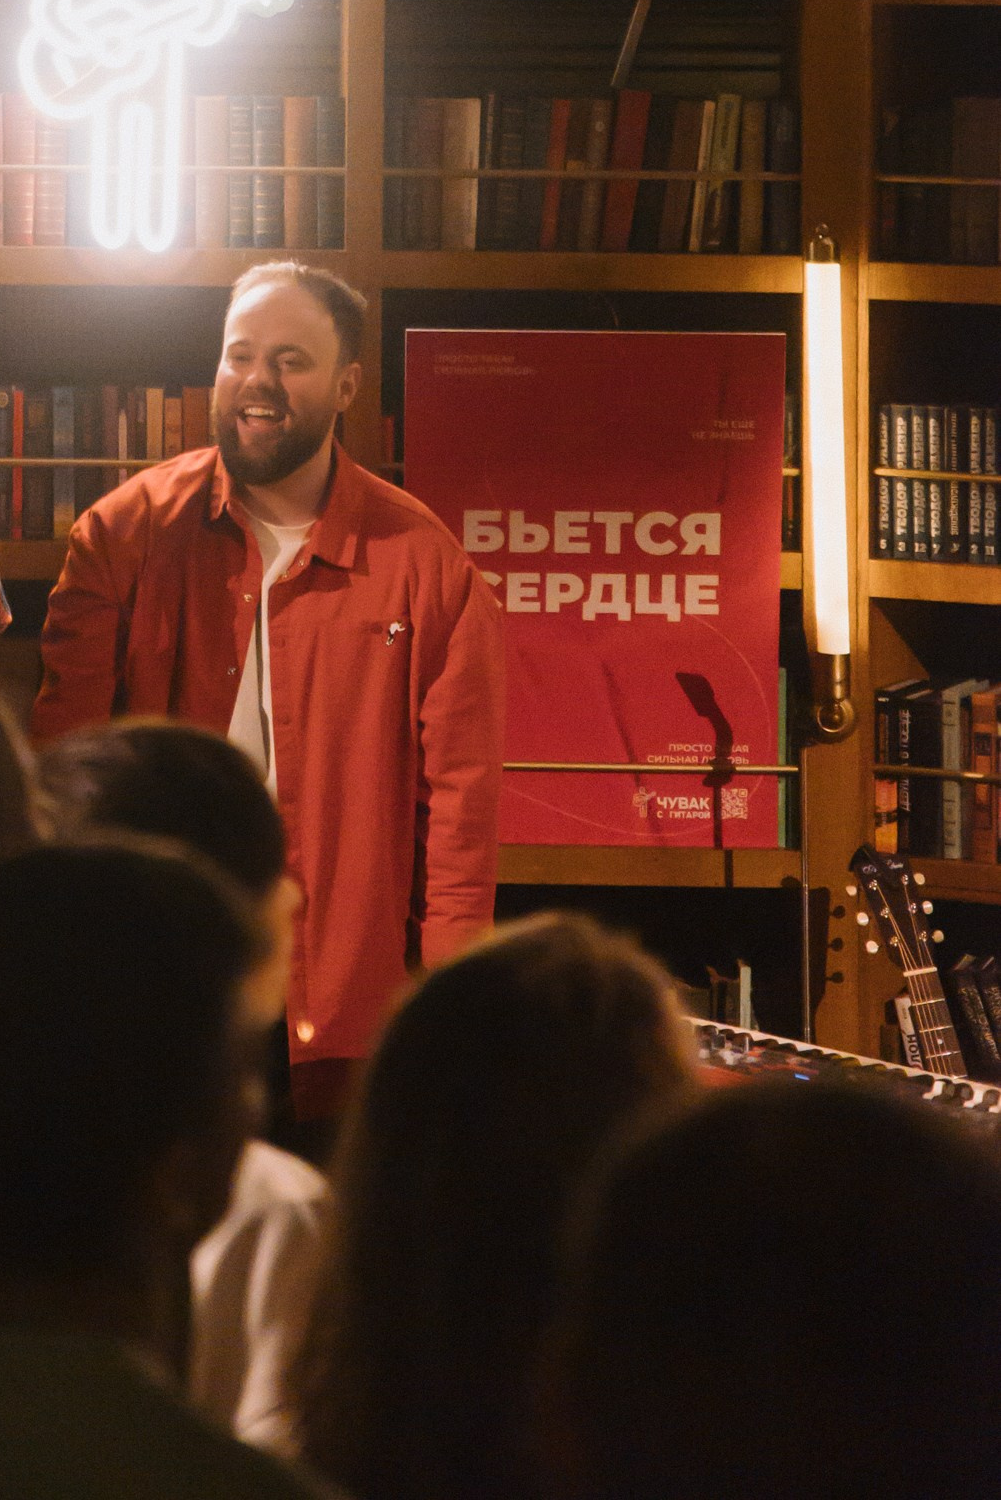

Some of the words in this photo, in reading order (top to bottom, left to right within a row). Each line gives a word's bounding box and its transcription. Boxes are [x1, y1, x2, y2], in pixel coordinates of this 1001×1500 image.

[896, 416, 907, 469] РАЙЗЕР
[912, 415, 924, 470] РАЙЗЕР
[929, 418, 941, 471] РАЙЗЕР
[462, 509, 722, 556] БЬЕТСЯ
[896, 482, 908, 536] ТЕОДОР
[913, 481, 925, 535] ТЕОДОР
[930, 483, 941, 538] ТЕОДОР
[897, 541, 906, 552] 3
[647, 754, 699, 764] СИЛЬНАЯ
[668, 743, 713, 753] ПРОСТО
[656, 796, 711, 810] ЧУВАК
[656, 810, 664, 819] С
[669, 810, 711, 819] ГИТАРОЙ
